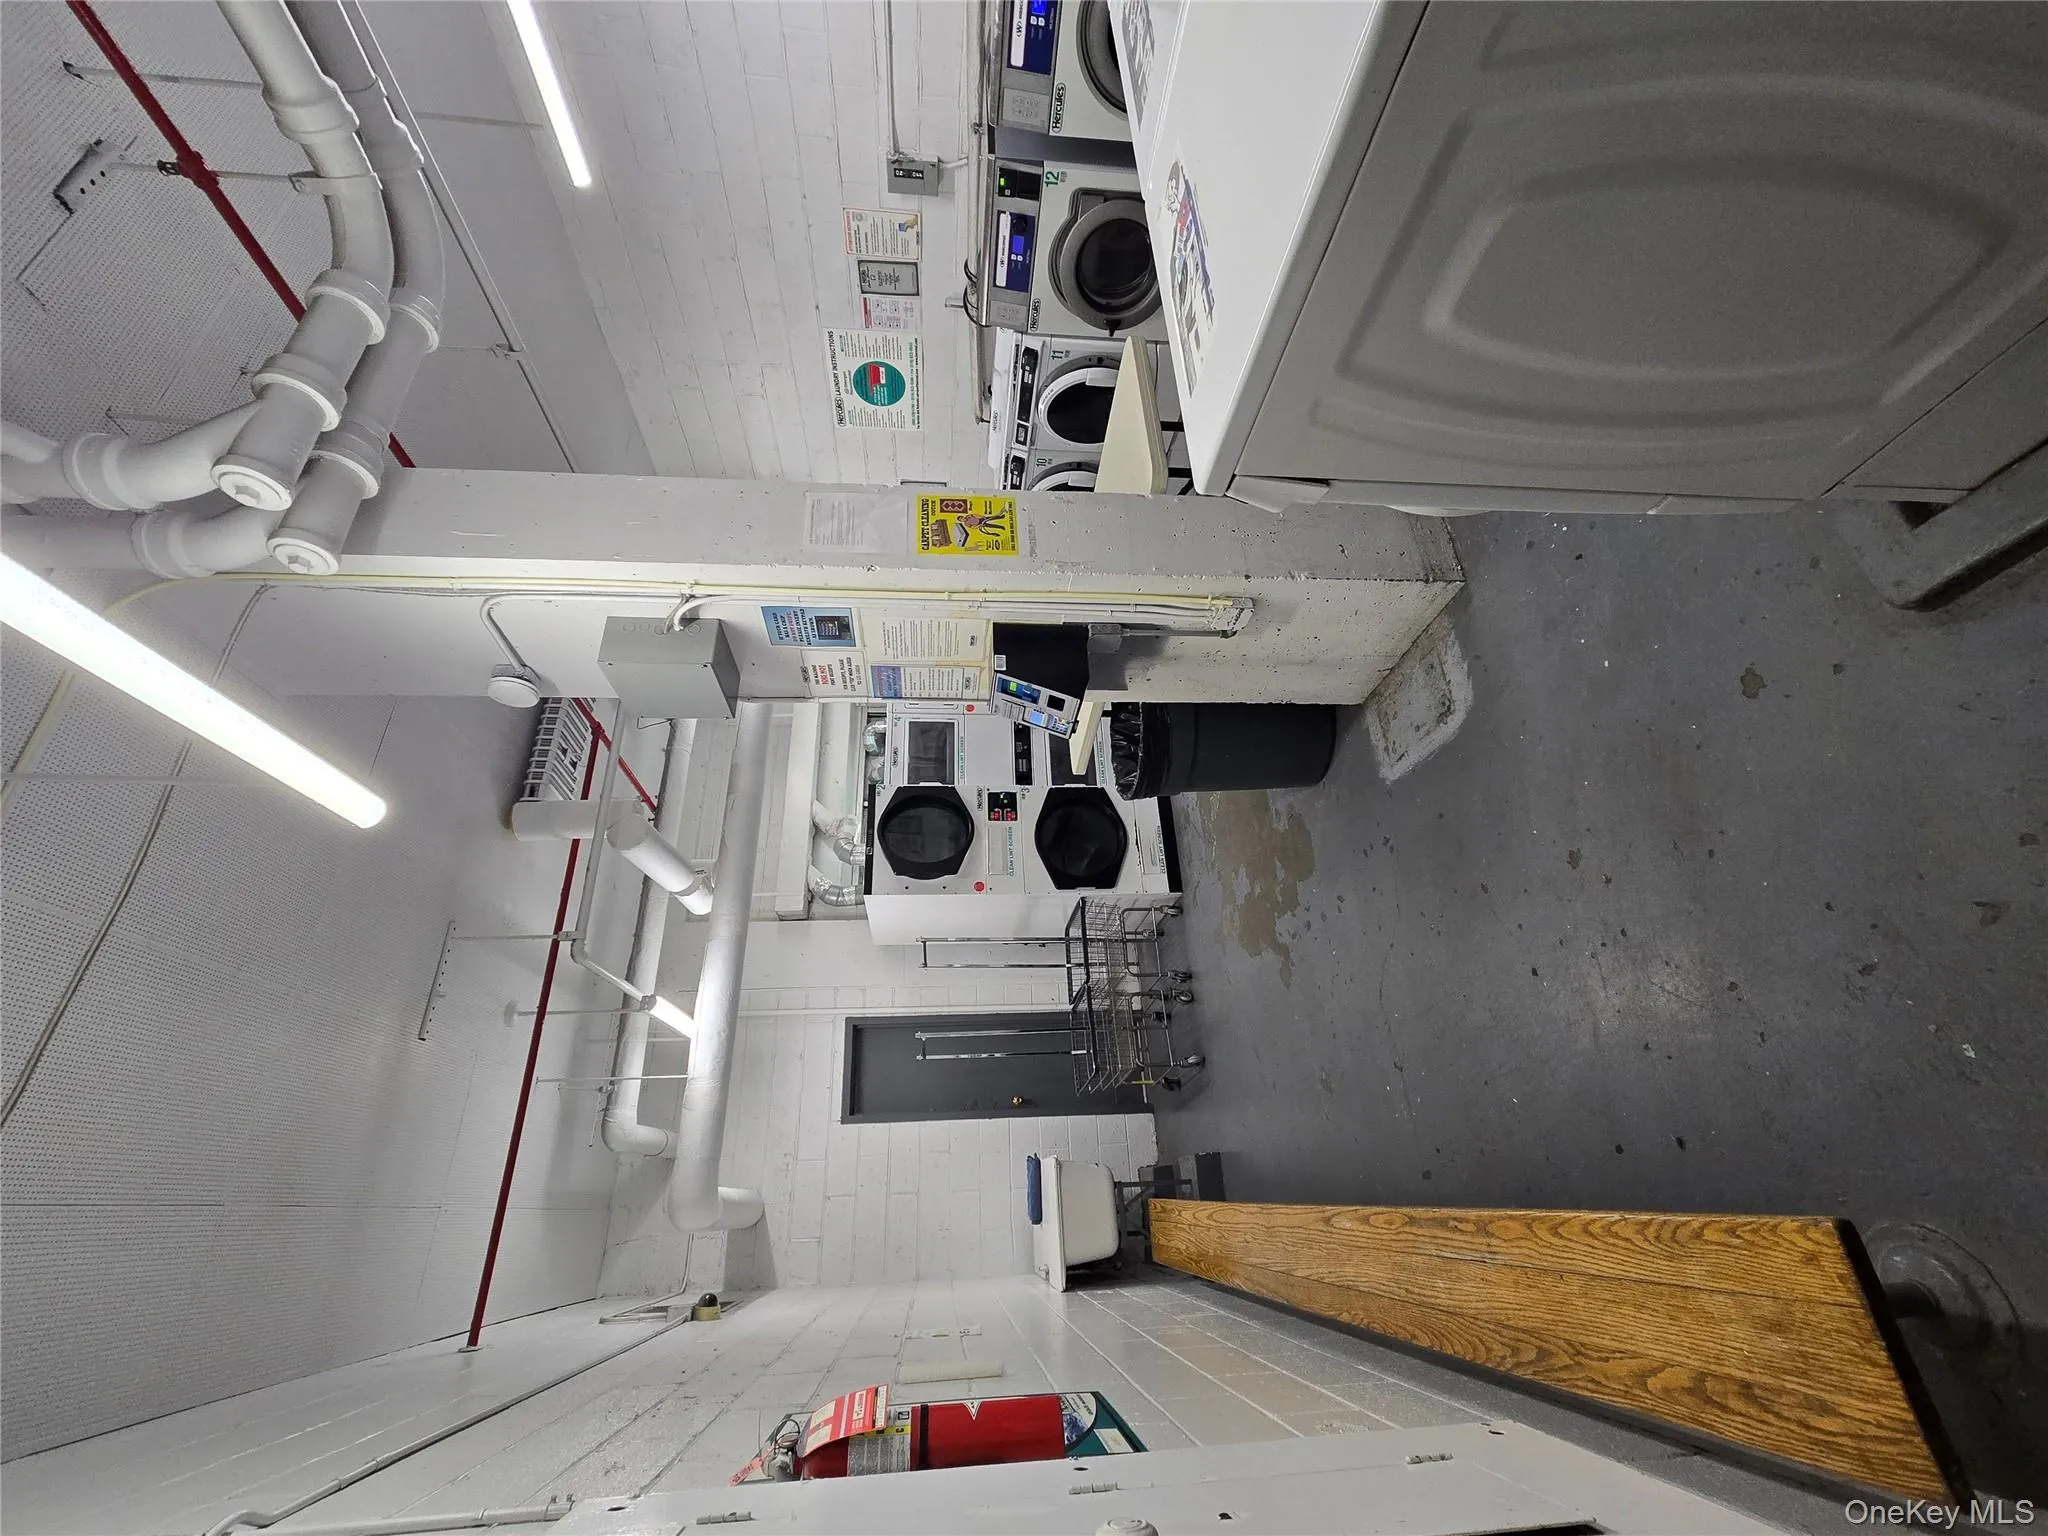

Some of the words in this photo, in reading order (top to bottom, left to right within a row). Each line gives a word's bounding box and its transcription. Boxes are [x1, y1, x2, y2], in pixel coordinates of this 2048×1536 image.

[1053, 86, 1064, 129] Hercules
[1044, 171, 1059, 188] 12
[1030, 300, 1040, 328] Hercules
[828, 330, 837, 371] INSTRUCTIONS
[1051, 350, 1064, 360] 11
[832, 372, 841, 396] LAUNDRY
[1036, 458, 1048, 467] 10
[921, 498, 929, 526] CLEANING
[922, 527, 930, 550] CARPET
[772, 612, 780, 624] CARD
[793, 610, 801, 626] INSERT
[800, 609, 808, 625] KEYPAD
[796, 627, 804, 642] PLEASE
[821, 675, 829, 684] DOES
